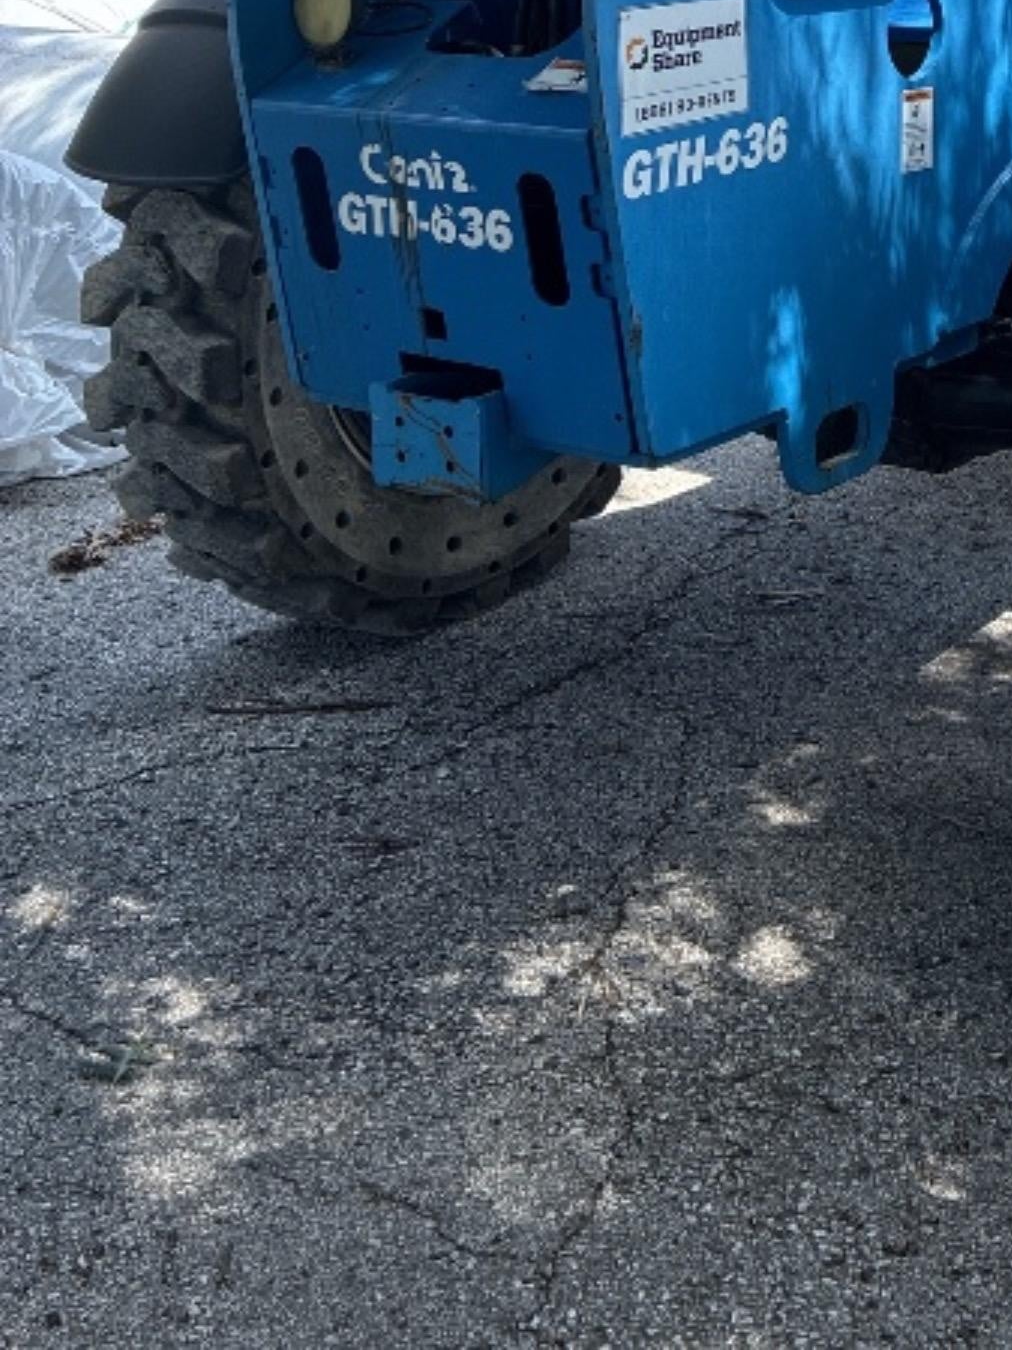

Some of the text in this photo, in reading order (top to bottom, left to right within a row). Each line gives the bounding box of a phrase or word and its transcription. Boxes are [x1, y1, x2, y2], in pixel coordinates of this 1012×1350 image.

[651, 20, 741, 51] Equipment
[652, 50, 703, 72] Share
[623, 116, 789, 200] GTH-636
[338, 191, 514, 253] GTH-636
